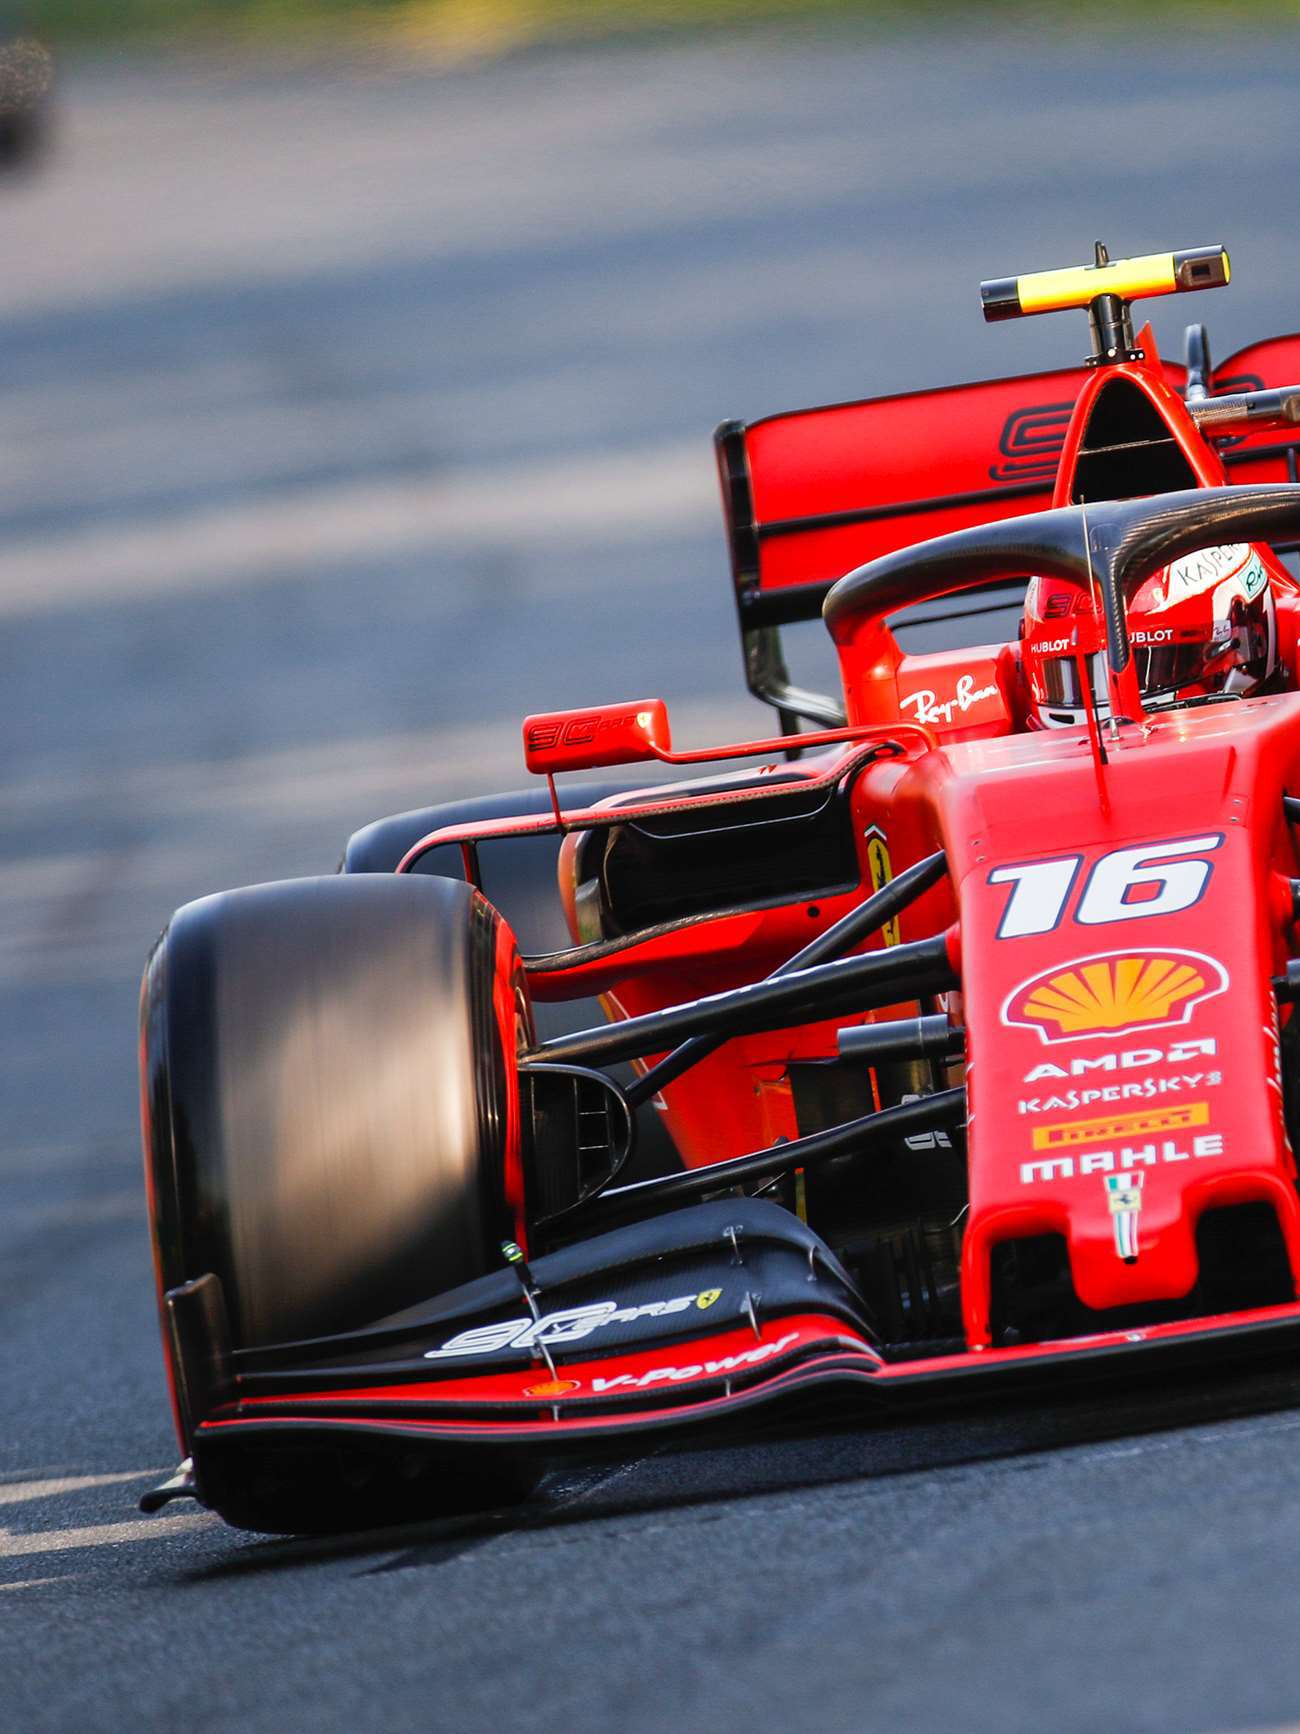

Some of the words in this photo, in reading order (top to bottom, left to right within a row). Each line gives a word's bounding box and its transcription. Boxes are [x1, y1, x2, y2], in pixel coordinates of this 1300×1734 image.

[1030, 638, 1070, 653] HUBLOT
[899, 674, 998, 724] Ray-Ban
[986, 832, 1225, 940] 16
[1020, 1134, 1224, 1184] MAHLE
[592, 1332, 799, 1392] V-Power
